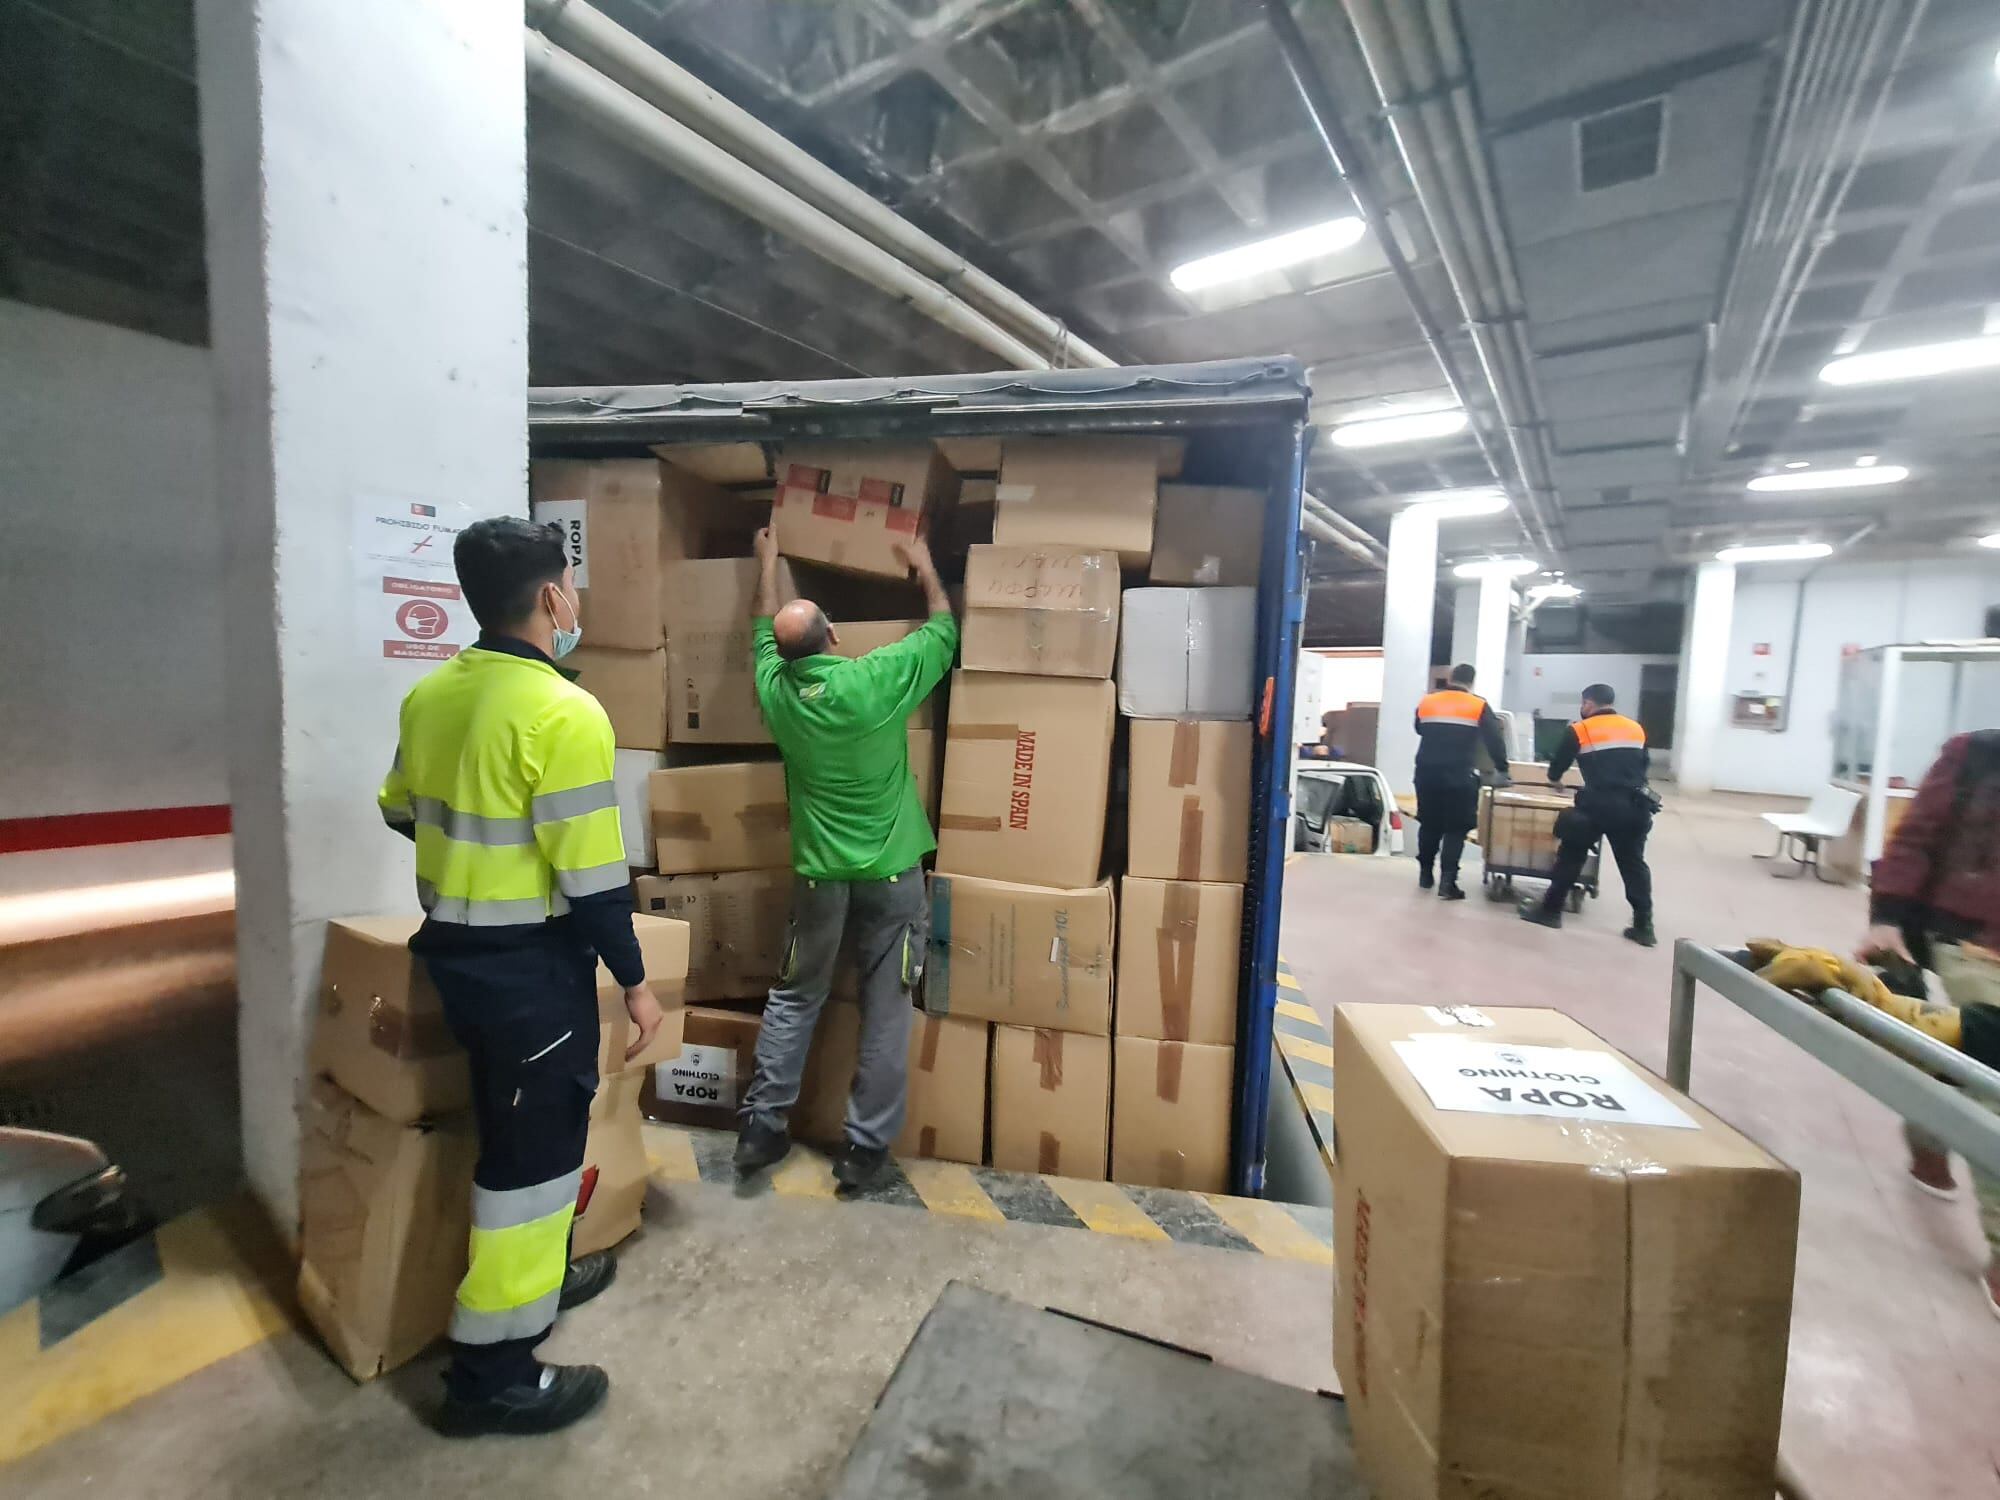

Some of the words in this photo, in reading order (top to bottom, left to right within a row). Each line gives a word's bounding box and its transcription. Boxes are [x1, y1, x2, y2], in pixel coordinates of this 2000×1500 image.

[375, 516, 430, 531] PROHIBIDO
[570, 519, 582, 567] ROPA
[391, 582, 453, 594] OBLIGATORIO
[405, 643, 426, 651] USO
[1016, 730, 1036, 770] MADE
[1013, 772, 1032, 788] IN
[1009, 790, 1030, 830] SPAIN
[671, 1067, 720, 1080] CLOTHING
[1458, 1068, 1601, 1085] CLOTHING
[673, 1083, 718, 1100] ROPA
[1478, 1086, 1627, 1112] ROPA
